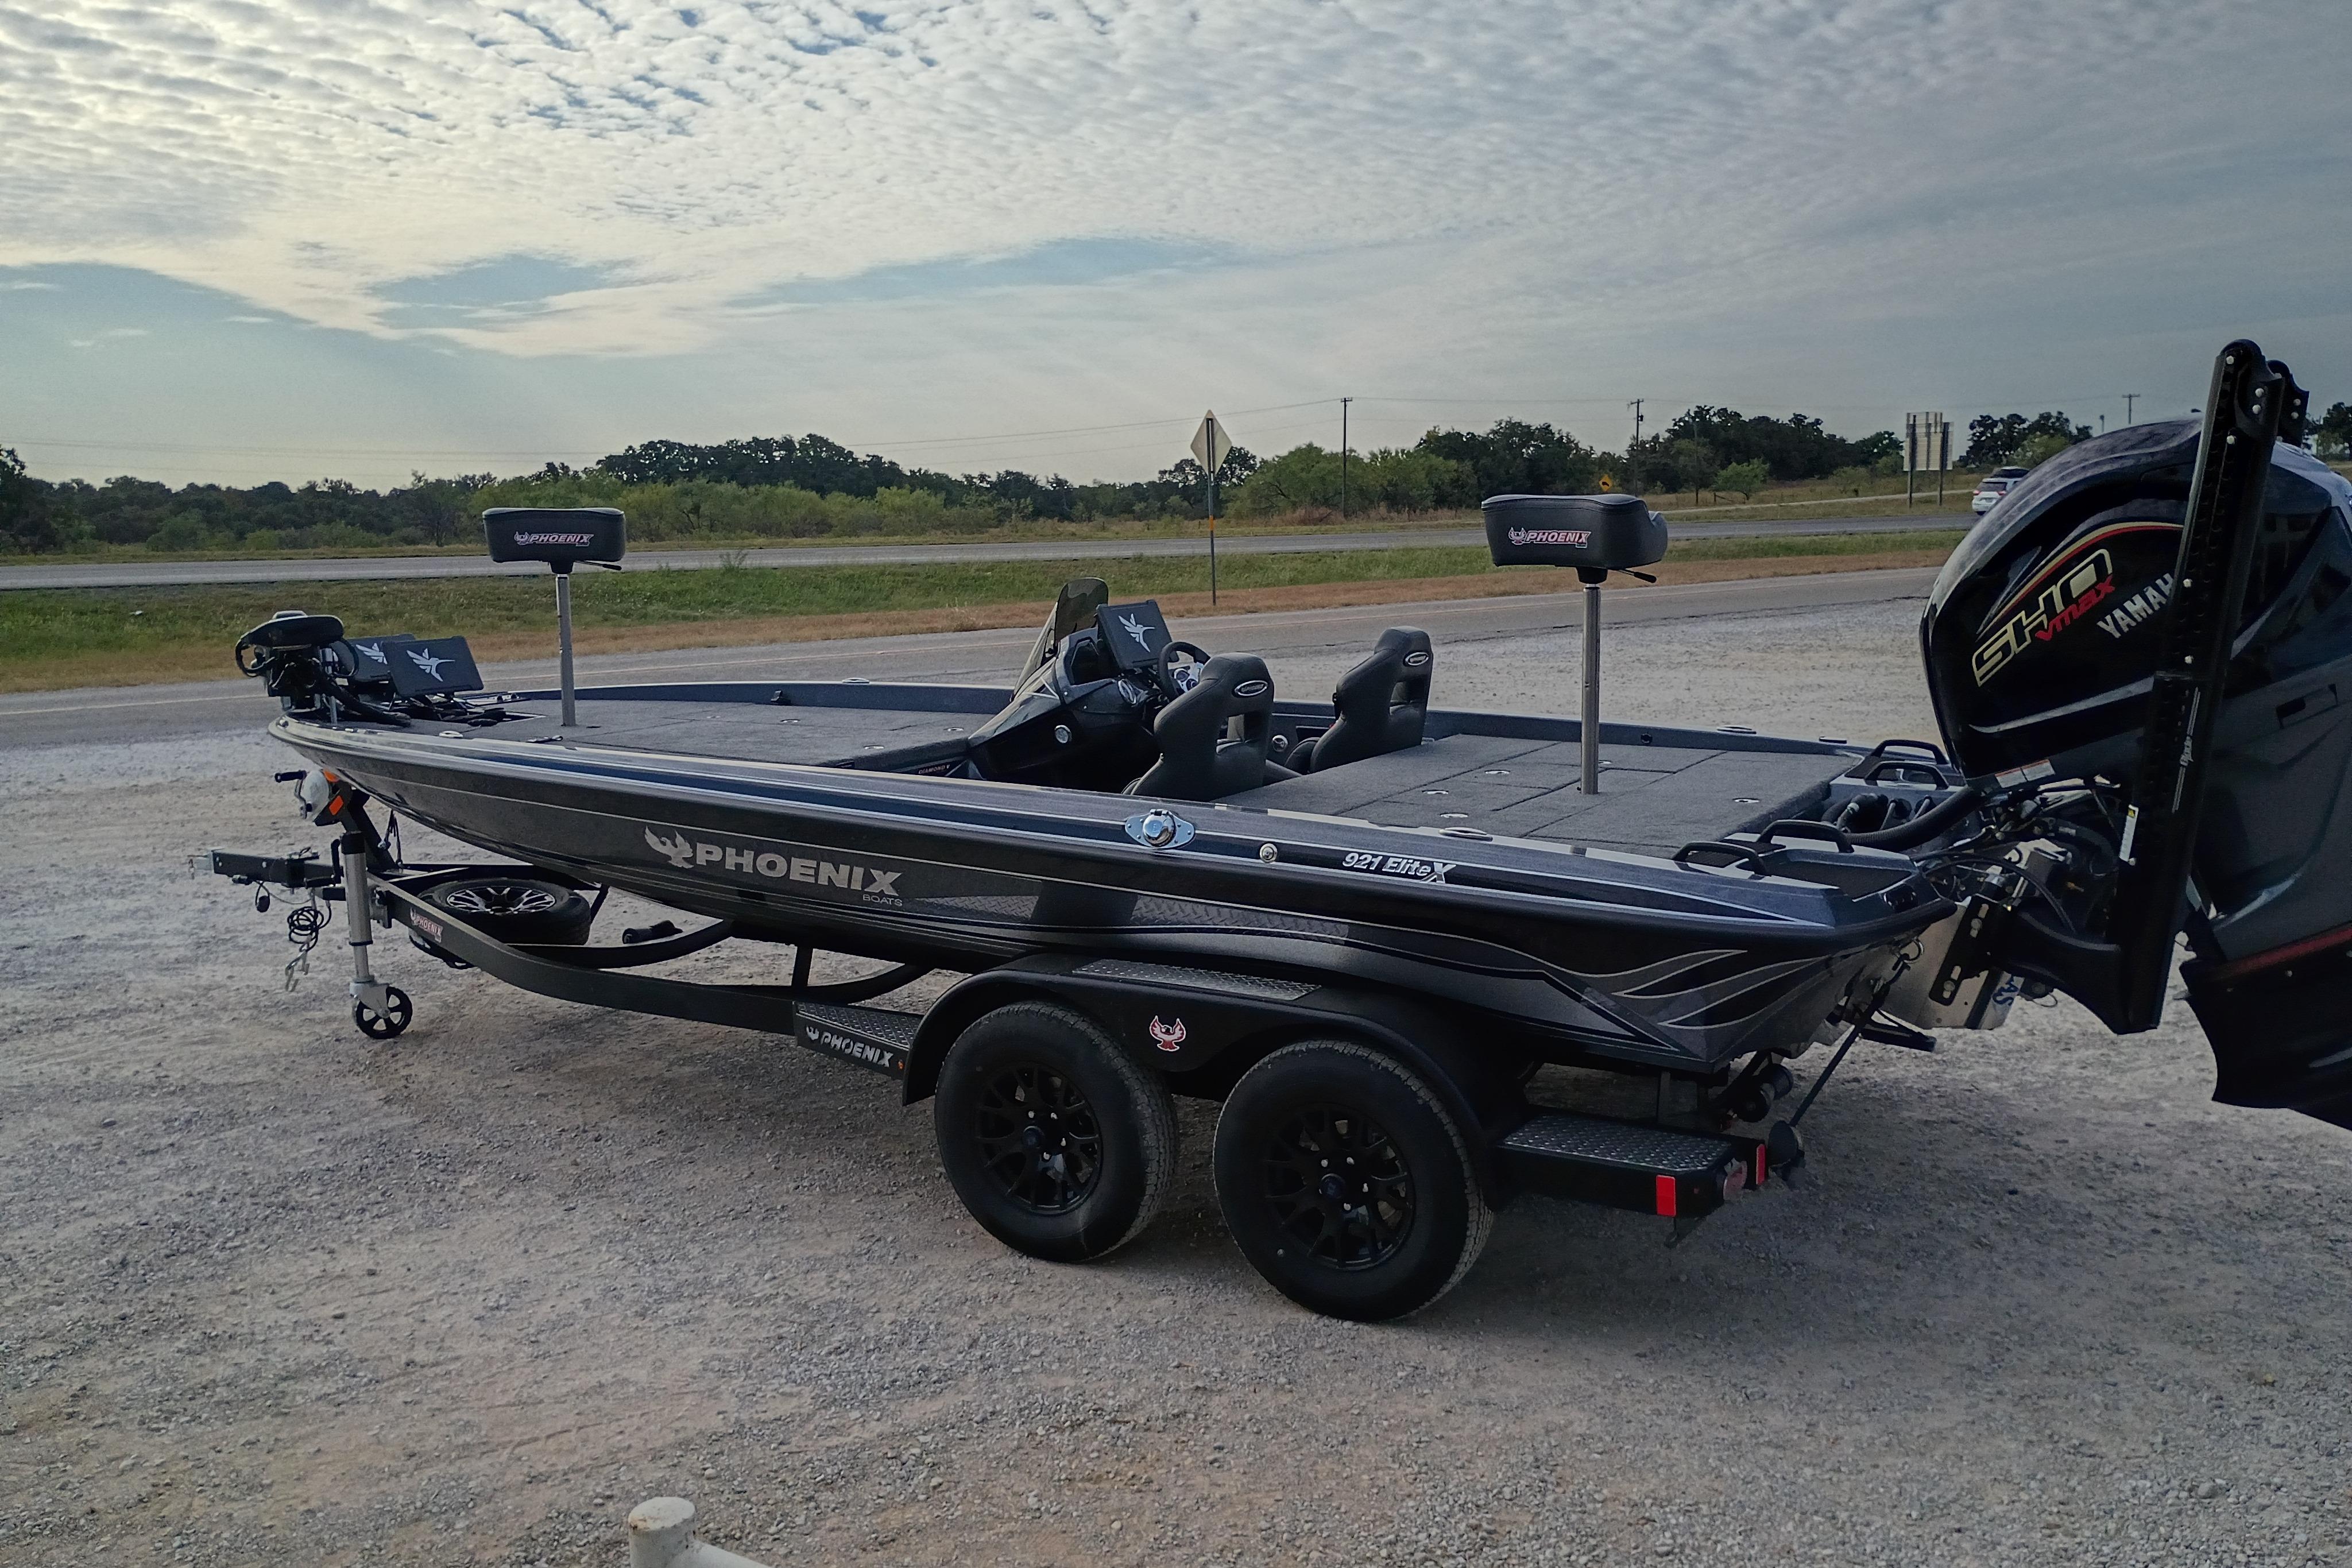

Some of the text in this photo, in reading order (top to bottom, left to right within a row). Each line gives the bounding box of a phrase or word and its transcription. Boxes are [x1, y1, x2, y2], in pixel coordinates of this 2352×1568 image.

[529, 535, 591, 543] PHOENIX
[1525, 532, 1589, 543] PHOENIX
[2096, 573, 2174, 638] YAMAH
[1972, 548, 2113, 687] SHO
[696, 842, 902, 896] PHOENIX
[1342, 853, 1383, 870] 921
[862, 894, 903, 907] BOATS
[415, 916, 442, 935] PHOENIX
[820, 1031, 893, 1067] PHOENIX
